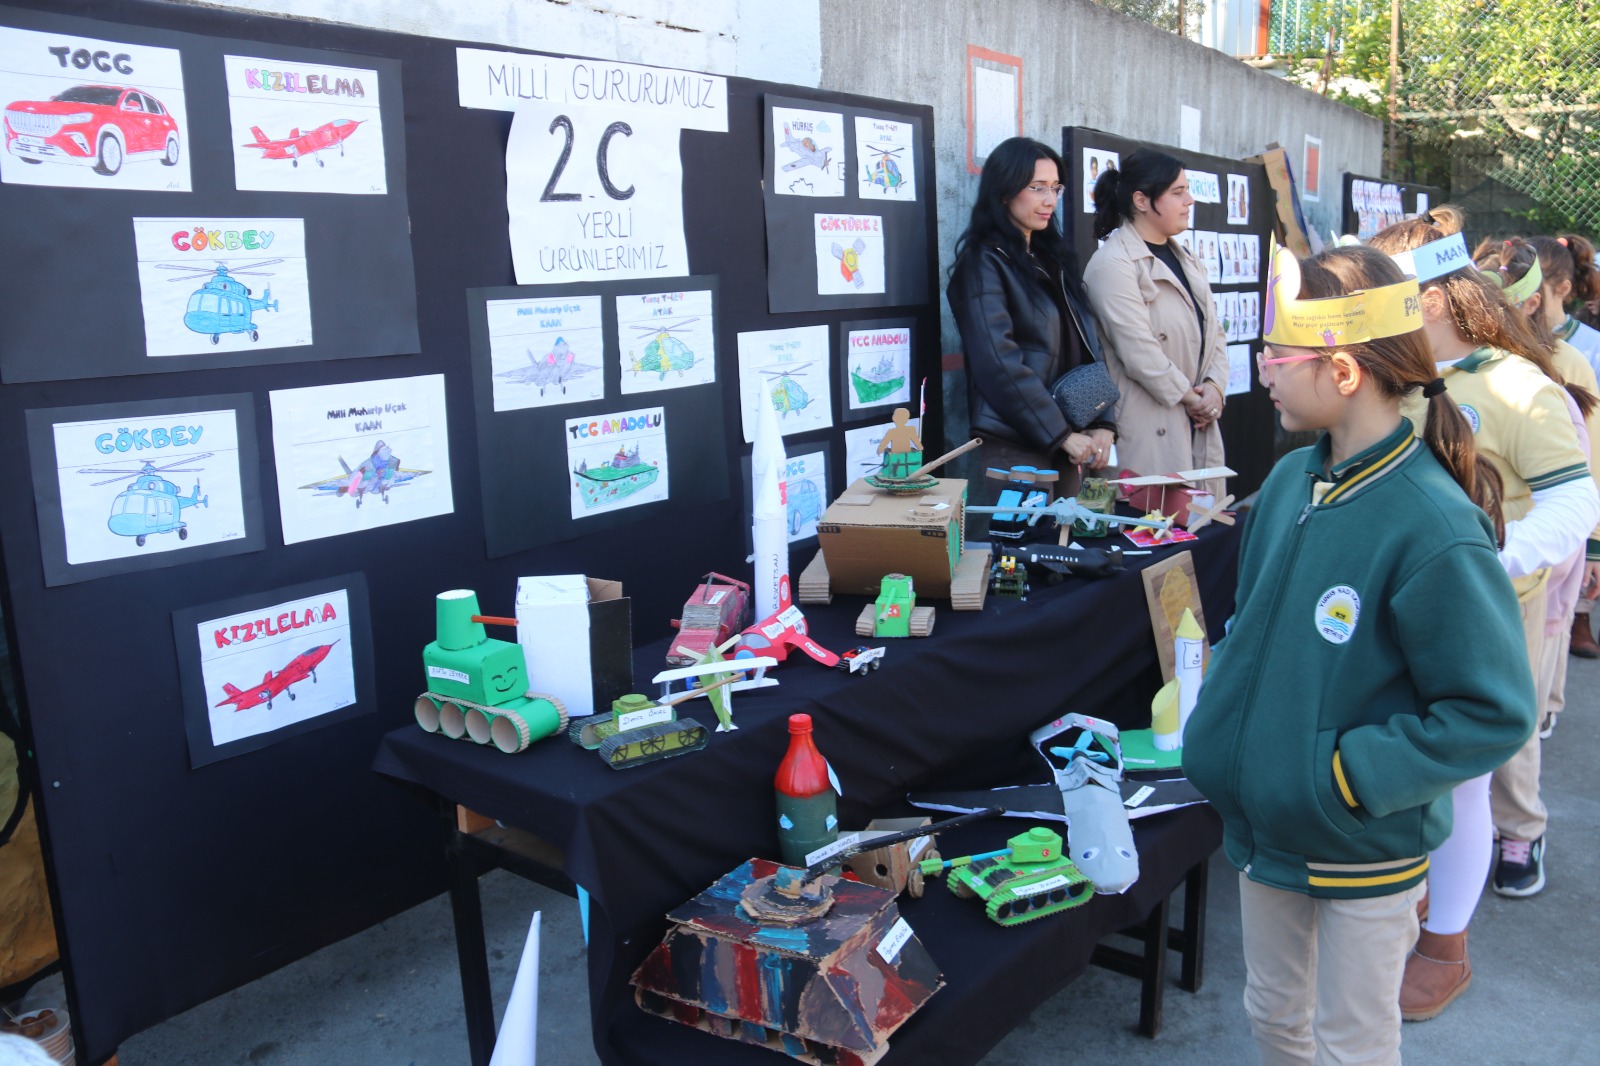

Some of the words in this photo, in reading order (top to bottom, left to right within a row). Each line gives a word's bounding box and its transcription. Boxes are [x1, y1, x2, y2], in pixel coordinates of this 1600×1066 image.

[48, 46, 134, 75] TOGG
[245, 68, 365, 98] KIZILELMA
[488, 63, 549, 100] MİLLİ
[572, 64, 715, 108] GURURUMUZ
[577, 207, 632, 238] YERLİ
[820, 216, 870, 231] GÖKTÜRK
[171, 226, 274, 252] GÖKBEY
[539, 242, 668, 272] ÜRÜNLERİMİZ
[871, 332, 908, 346] ANADOLU
[327, 409, 346, 420] Milli
[348, 406, 383, 417] Muharip
[385, 402, 407, 414] Uçak
[601, 412, 662, 436] ANADOLU
[95, 425, 203, 454] GÖKBEY
[355, 420, 383, 432] KAAN
[214, 602, 337, 649] KIZILELMA
